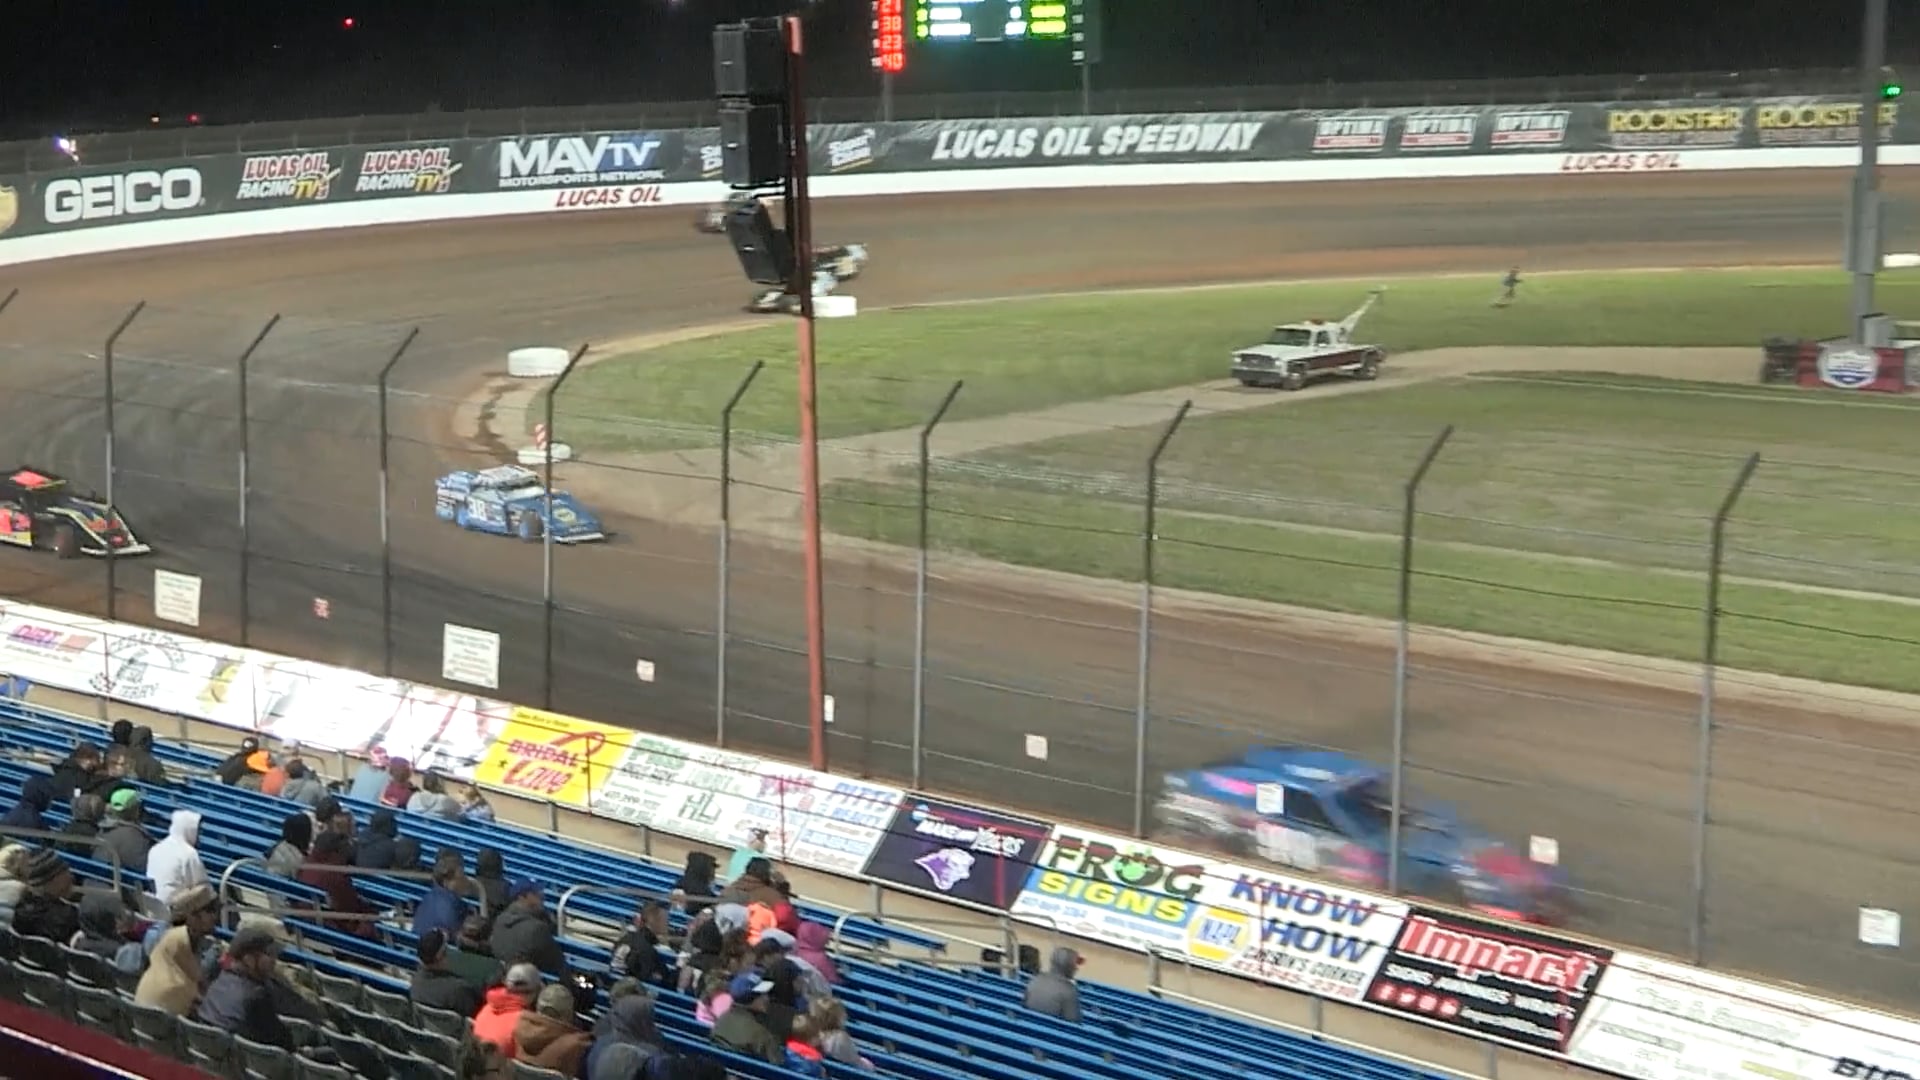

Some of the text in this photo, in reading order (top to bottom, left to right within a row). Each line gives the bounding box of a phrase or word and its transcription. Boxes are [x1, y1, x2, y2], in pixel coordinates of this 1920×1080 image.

[882, 16, 902, 31] 38
[882, 35, 902, 49] 23
[931, 121, 1267, 160] LUCAS OIL SPEEDWAY
[243, 152, 330, 181] LUCAS OIL
[361, 148, 451, 175] LUCAS OIL
[500, 136, 662, 177] MAVTV
[1561, 152, 1683, 172] LUCAS OIL
[236, 180, 297, 200] RACING
[355, 173, 416, 192] RACING
[499, 169, 665, 187] MOTORSPORTS NETWORK
[44, 168, 202, 224] GEICO
[555, 186, 664, 208] LUCAS OIL
[507, 739, 579, 767] BRIDAL
[1048, 834, 1206, 901] FROG
[1038, 871, 1188, 923] SIGNS
[1229, 873, 1379, 927] KNOW
[1260, 917, 1376, 963] HOW
[1397, 916, 1598, 996] Impact
